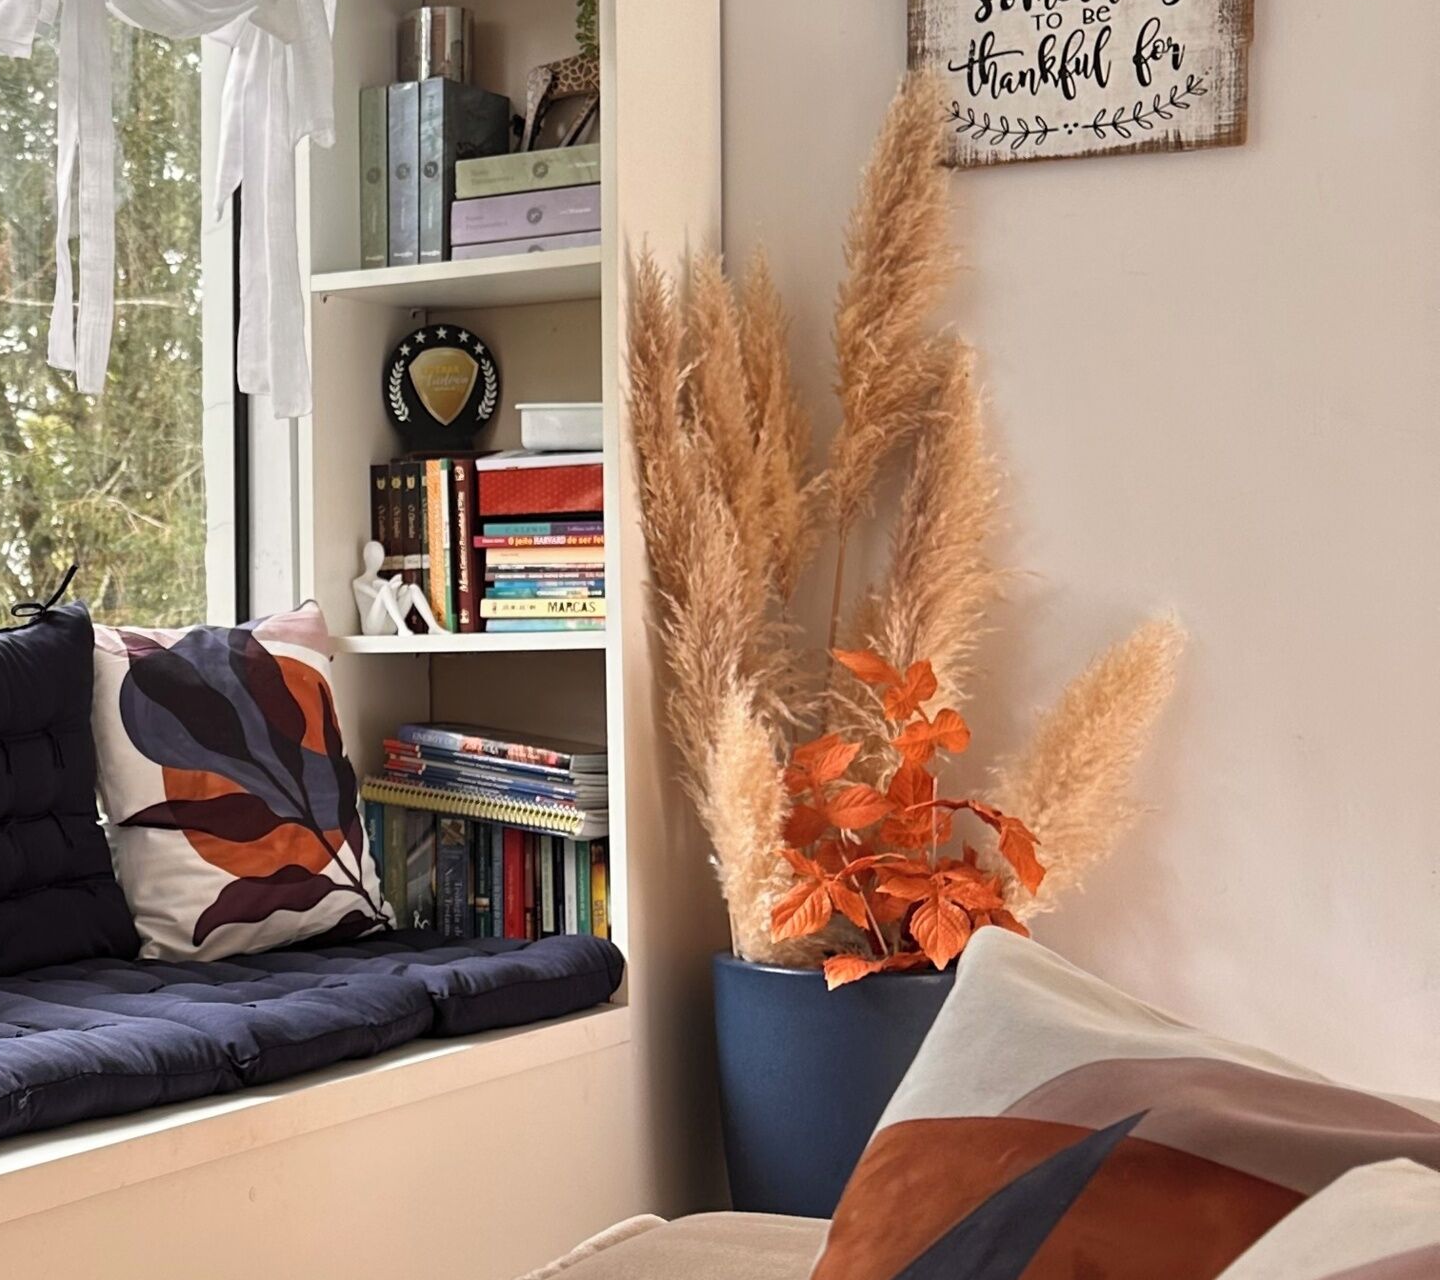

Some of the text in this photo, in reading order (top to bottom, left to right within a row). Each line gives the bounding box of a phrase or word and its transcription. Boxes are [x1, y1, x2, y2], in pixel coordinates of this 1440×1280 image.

[1032, 12, 1062, 30] TO
[948, 17, 1185, 100] thankful for
[508, 537, 513, 545] O
[515, 537, 533, 546] jeito
[533, 536, 566, 544] HARVARD
[567, 536, 576, 544] de
[548, 602, 595, 612] MARCAS
